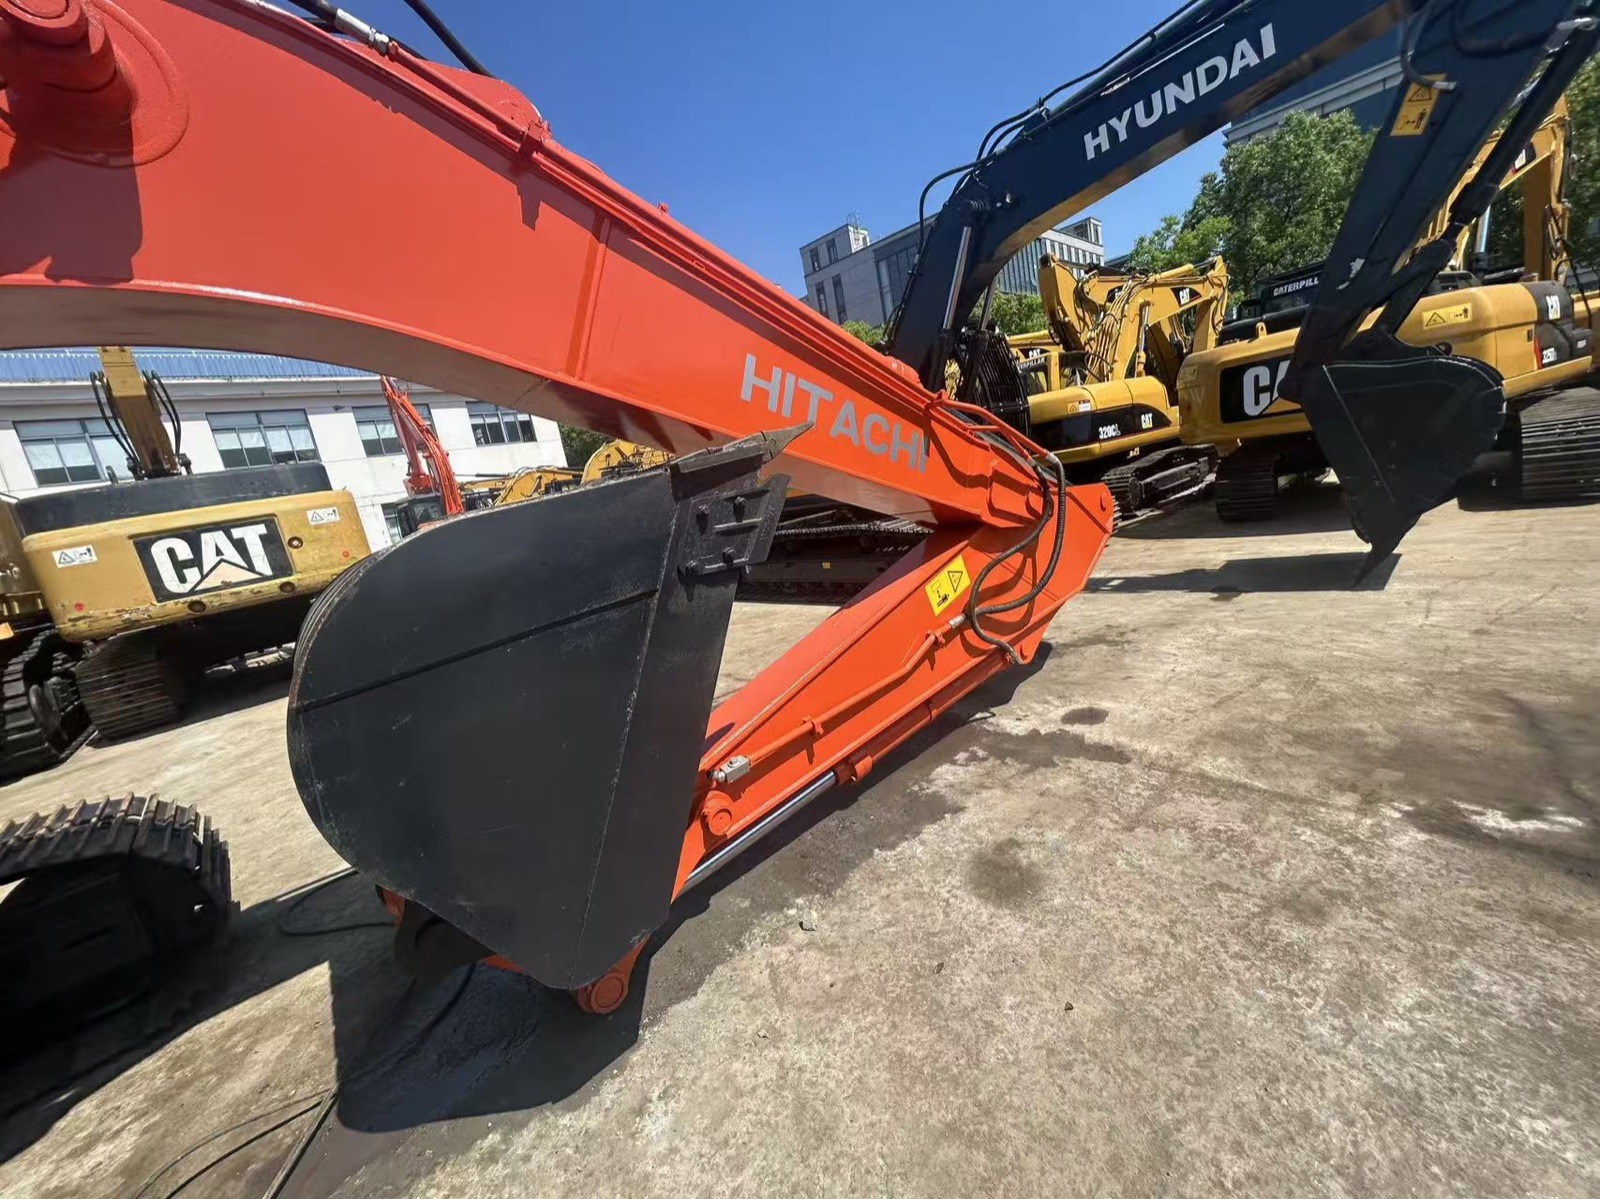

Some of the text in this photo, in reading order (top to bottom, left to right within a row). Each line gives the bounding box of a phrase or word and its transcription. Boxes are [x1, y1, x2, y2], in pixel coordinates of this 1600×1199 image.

[1083, 22, 1276, 161] HYUNDAI
[1178, 287, 1190, 305] CAT
[1545, 294, 1561, 320] CAT
[740, 352, 930, 474] HITACHI
[1141, 412, 1153, 429] CAT
[150, 523, 273, 593] CAT
